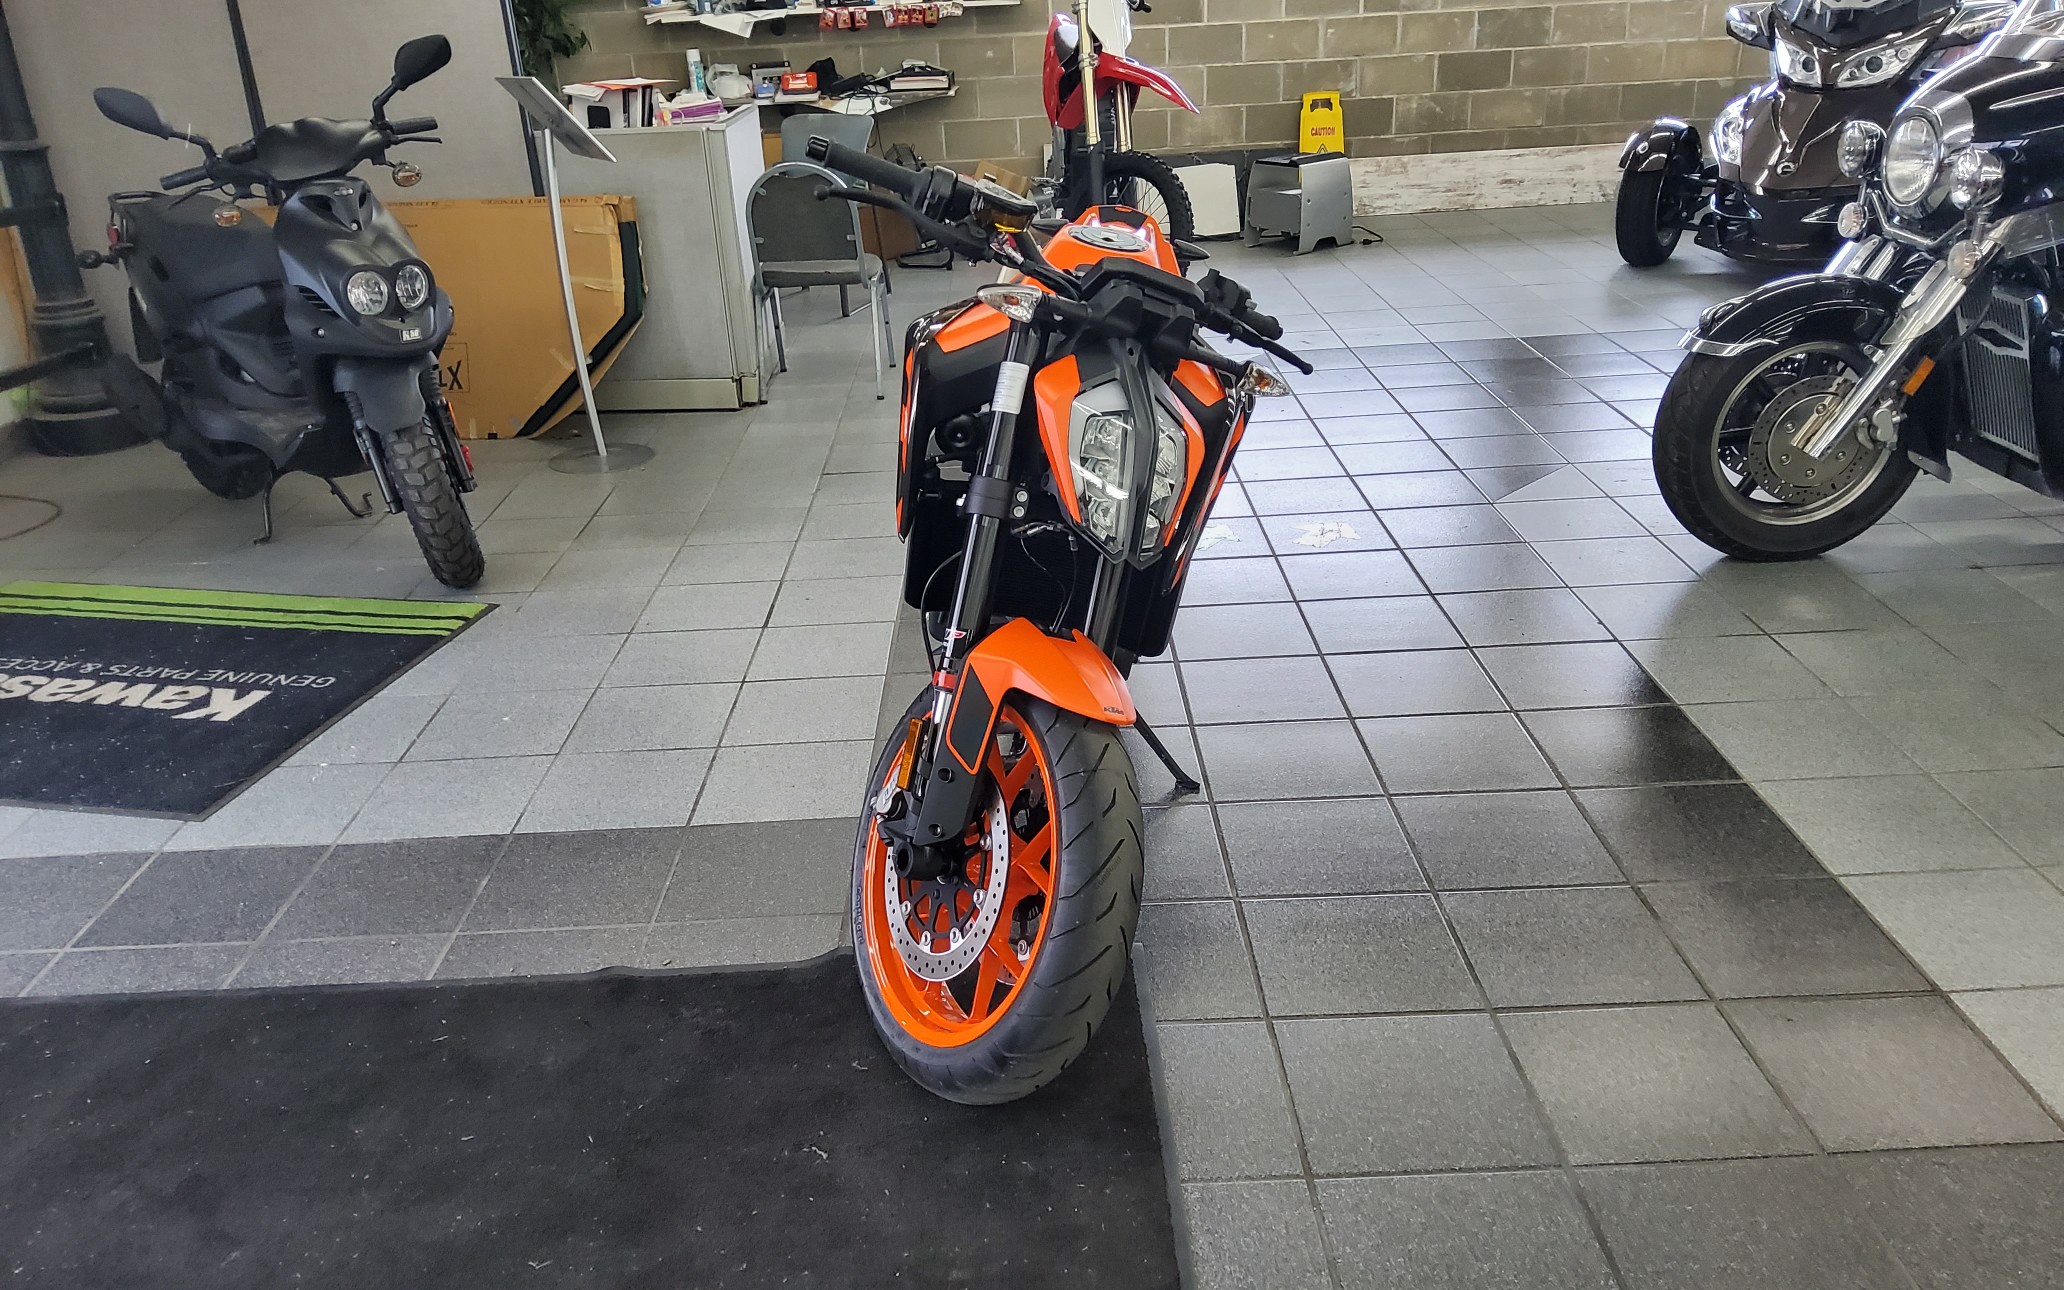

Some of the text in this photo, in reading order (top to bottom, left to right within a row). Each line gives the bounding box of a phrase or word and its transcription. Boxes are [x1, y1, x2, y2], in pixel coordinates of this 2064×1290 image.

[1310, 126, 1336, 136] CAUTION
[0, 658, 337, 688] GENUINE PARTS & ACCE
[1103, 706, 1124, 715] KTM
